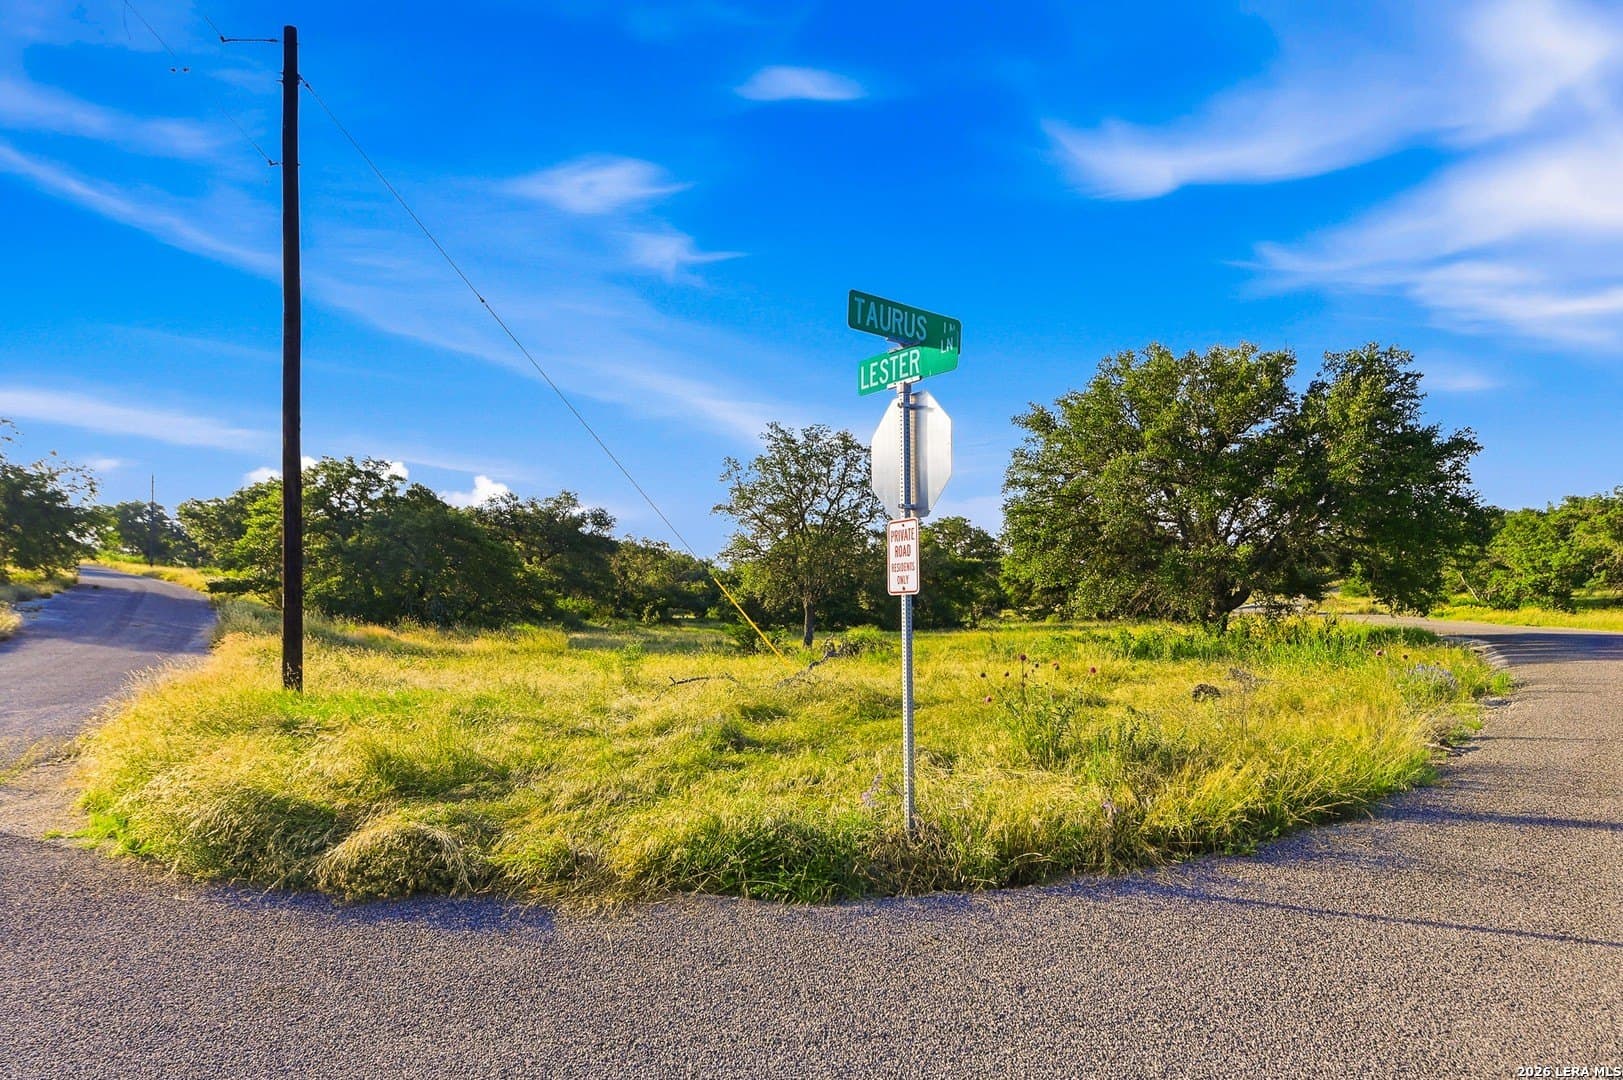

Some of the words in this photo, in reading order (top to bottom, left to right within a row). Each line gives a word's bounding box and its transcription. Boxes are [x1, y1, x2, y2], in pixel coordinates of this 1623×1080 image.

[854, 296, 927, 341] TAURUS
[861, 349, 920, 390] LESTER
[940, 337, 953, 353] LN
[890, 527, 915, 542] PRIVATE
[894, 543, 911, 557] ROAD
[891, 562, 915, 573] RESIDENTS
[897, 575, 909, 585] ONLY
